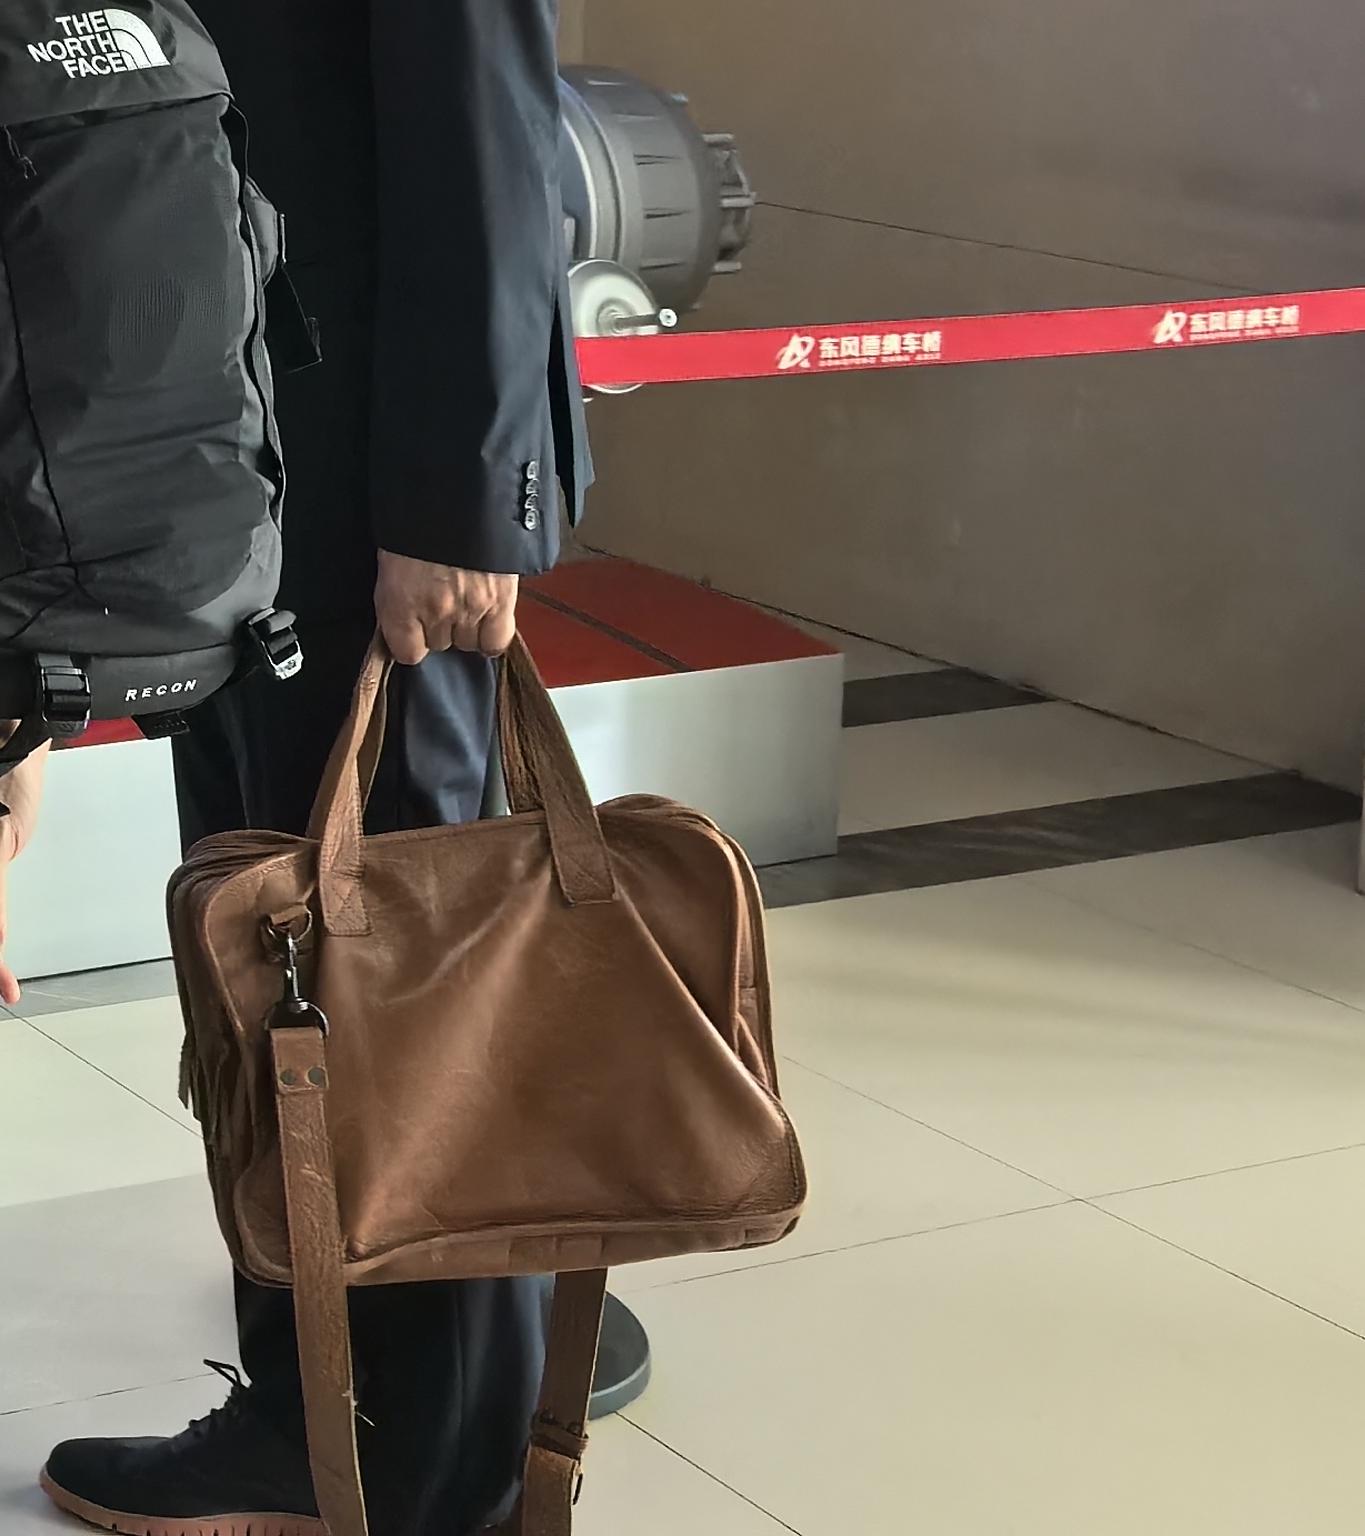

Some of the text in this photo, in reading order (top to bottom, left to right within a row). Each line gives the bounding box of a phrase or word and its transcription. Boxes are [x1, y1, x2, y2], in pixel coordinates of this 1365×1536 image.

[55, 10, 108, 37] THE
[27, 29, 118, 64] NORTH
[63, 52, 126, 79] FACE
[125, 679, 198, 702] RECON
